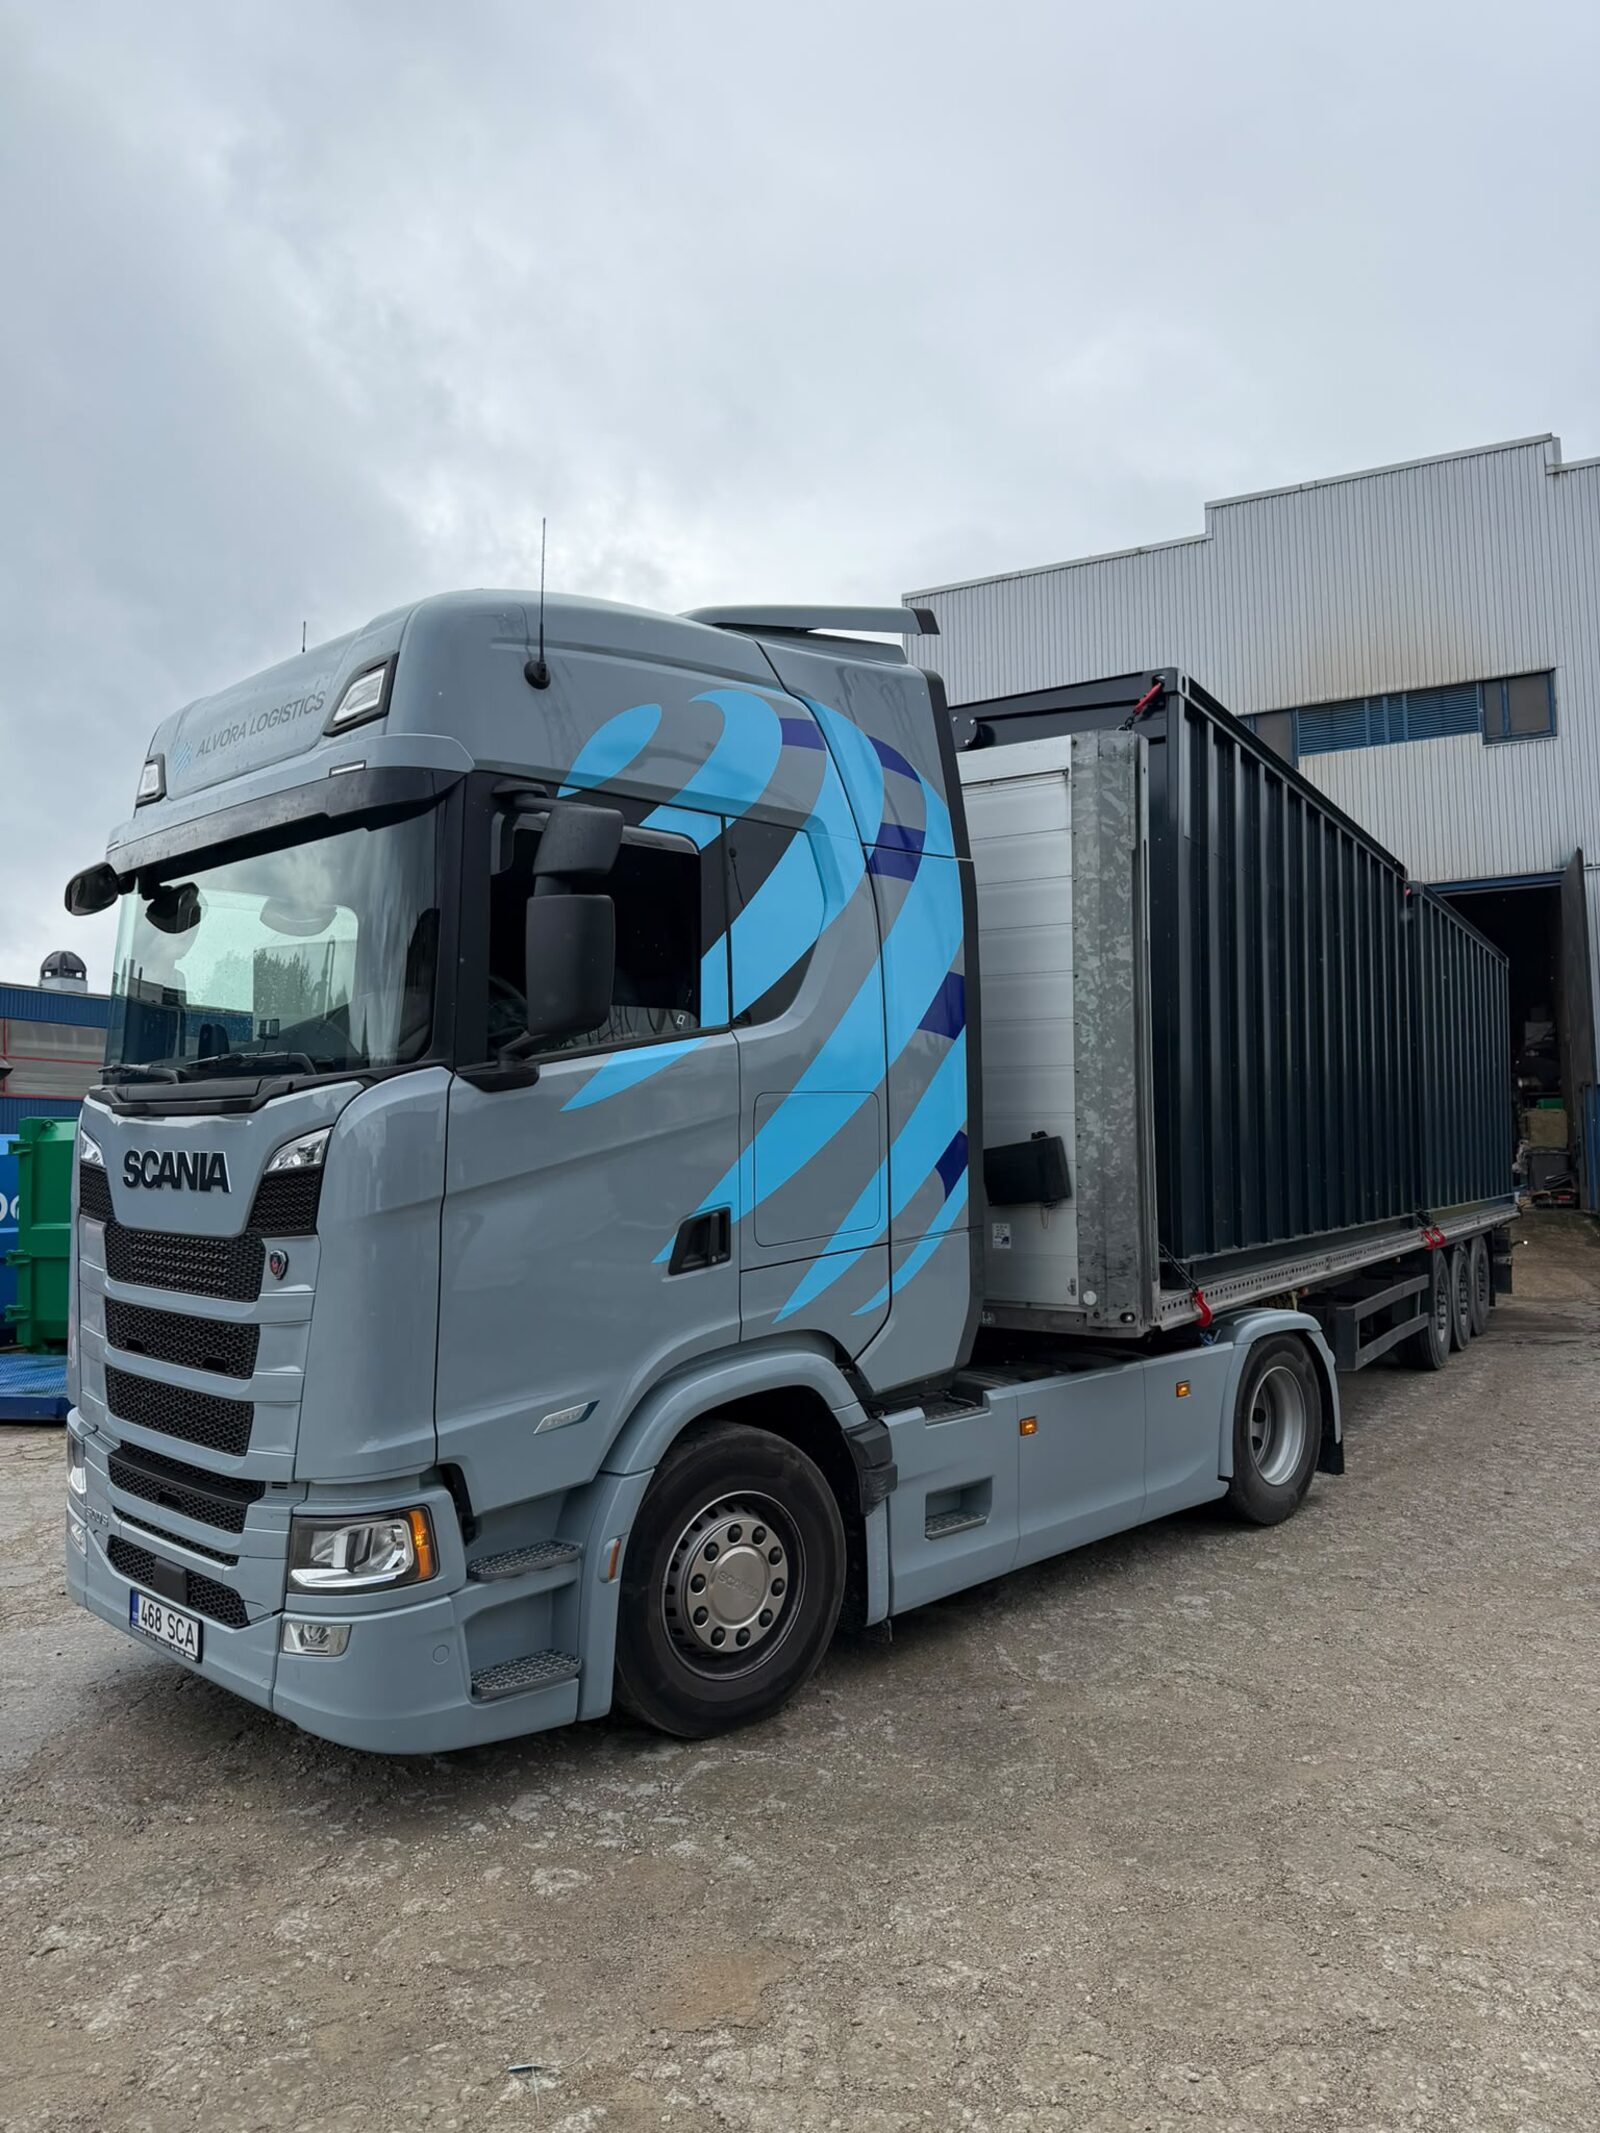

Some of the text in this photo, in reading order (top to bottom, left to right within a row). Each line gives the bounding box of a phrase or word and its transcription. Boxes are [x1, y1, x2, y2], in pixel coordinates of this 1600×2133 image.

[196, 691, 326, 758] ALVORA LOGISTICS
[122, 1149, 232, 1193] SCANIA
[141, 1600, 162, 1633] 468
[167, 1613, 196, 1652] SCA
